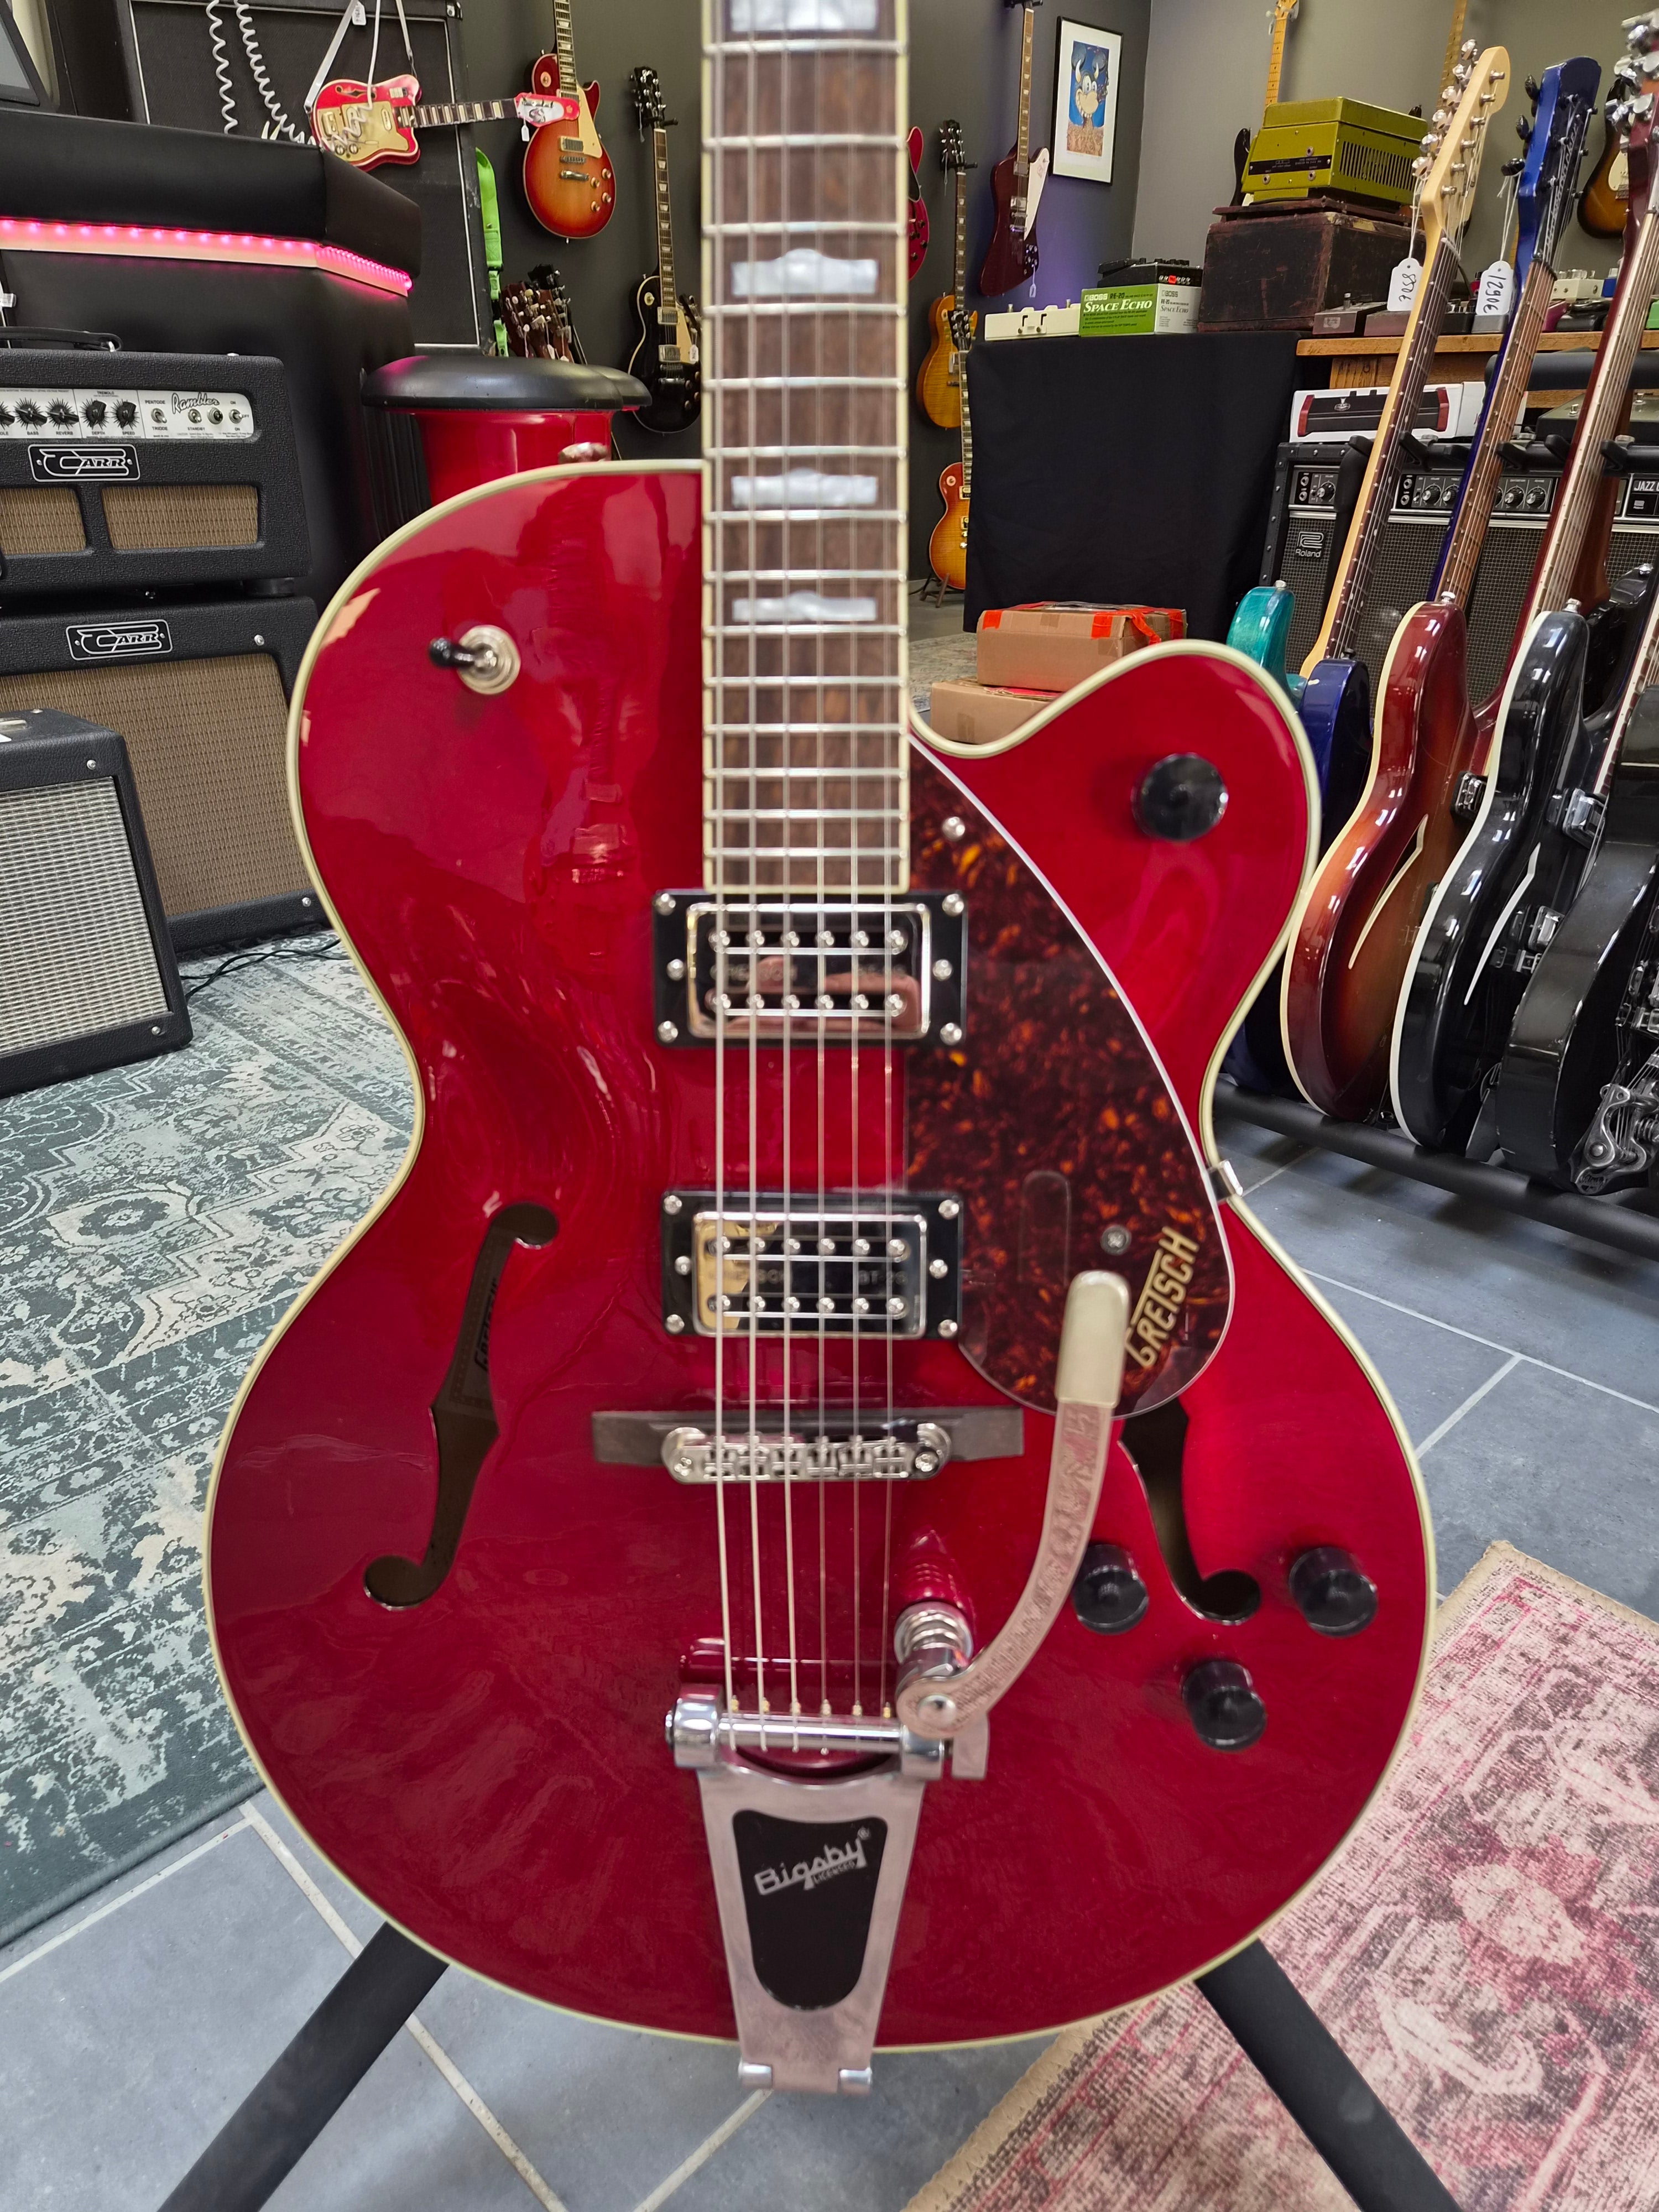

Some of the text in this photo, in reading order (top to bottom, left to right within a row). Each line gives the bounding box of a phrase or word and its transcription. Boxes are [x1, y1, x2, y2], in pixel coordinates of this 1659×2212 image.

[1083, 299, 1152, 313] SPACE ECHO
[1483, 275, 1507, 314] 1290€
[171, 392, 220, 415] Rambler
[1634, 481, 1656, 492] JAZZ
[1295, 549, 1322, 558] Roland
[1124, 1225, 1199, 1367] GRETSCH
[754, 1837, 867, 1895] Bigsby
